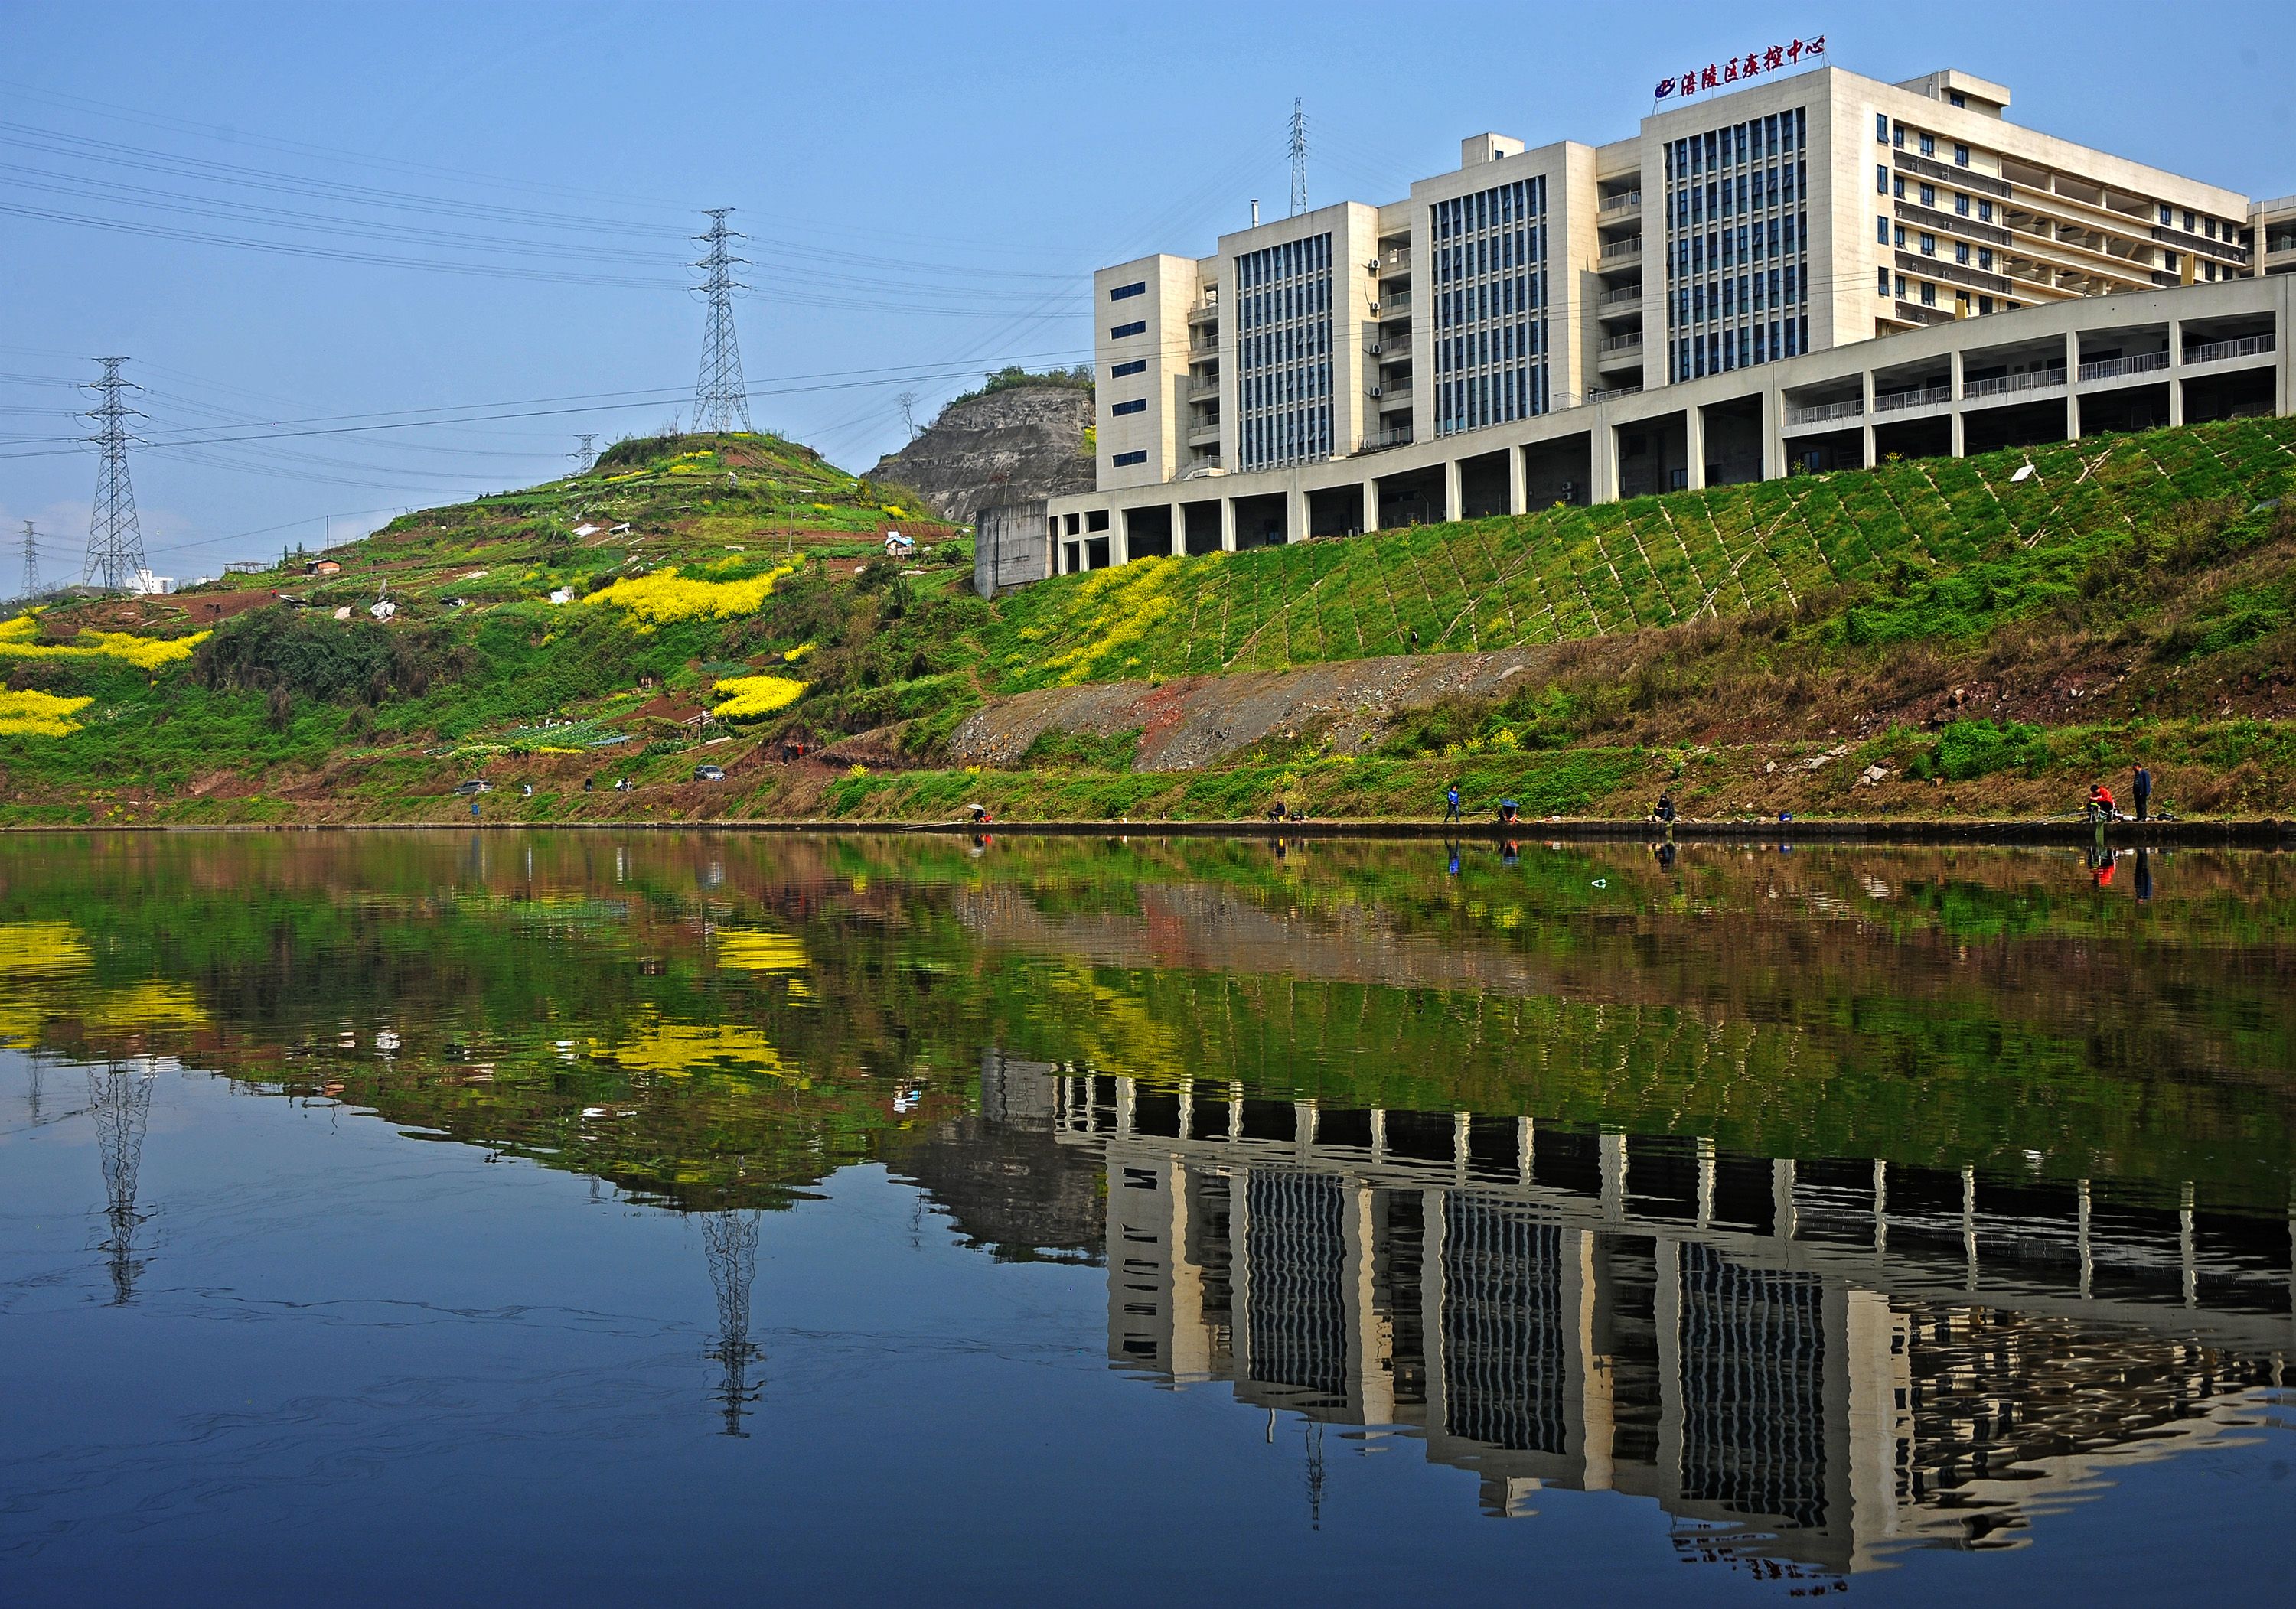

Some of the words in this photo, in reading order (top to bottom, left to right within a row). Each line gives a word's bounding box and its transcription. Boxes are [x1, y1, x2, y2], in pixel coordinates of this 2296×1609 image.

[1681, 37, 1825, 97] 涪陵区疾控中心
